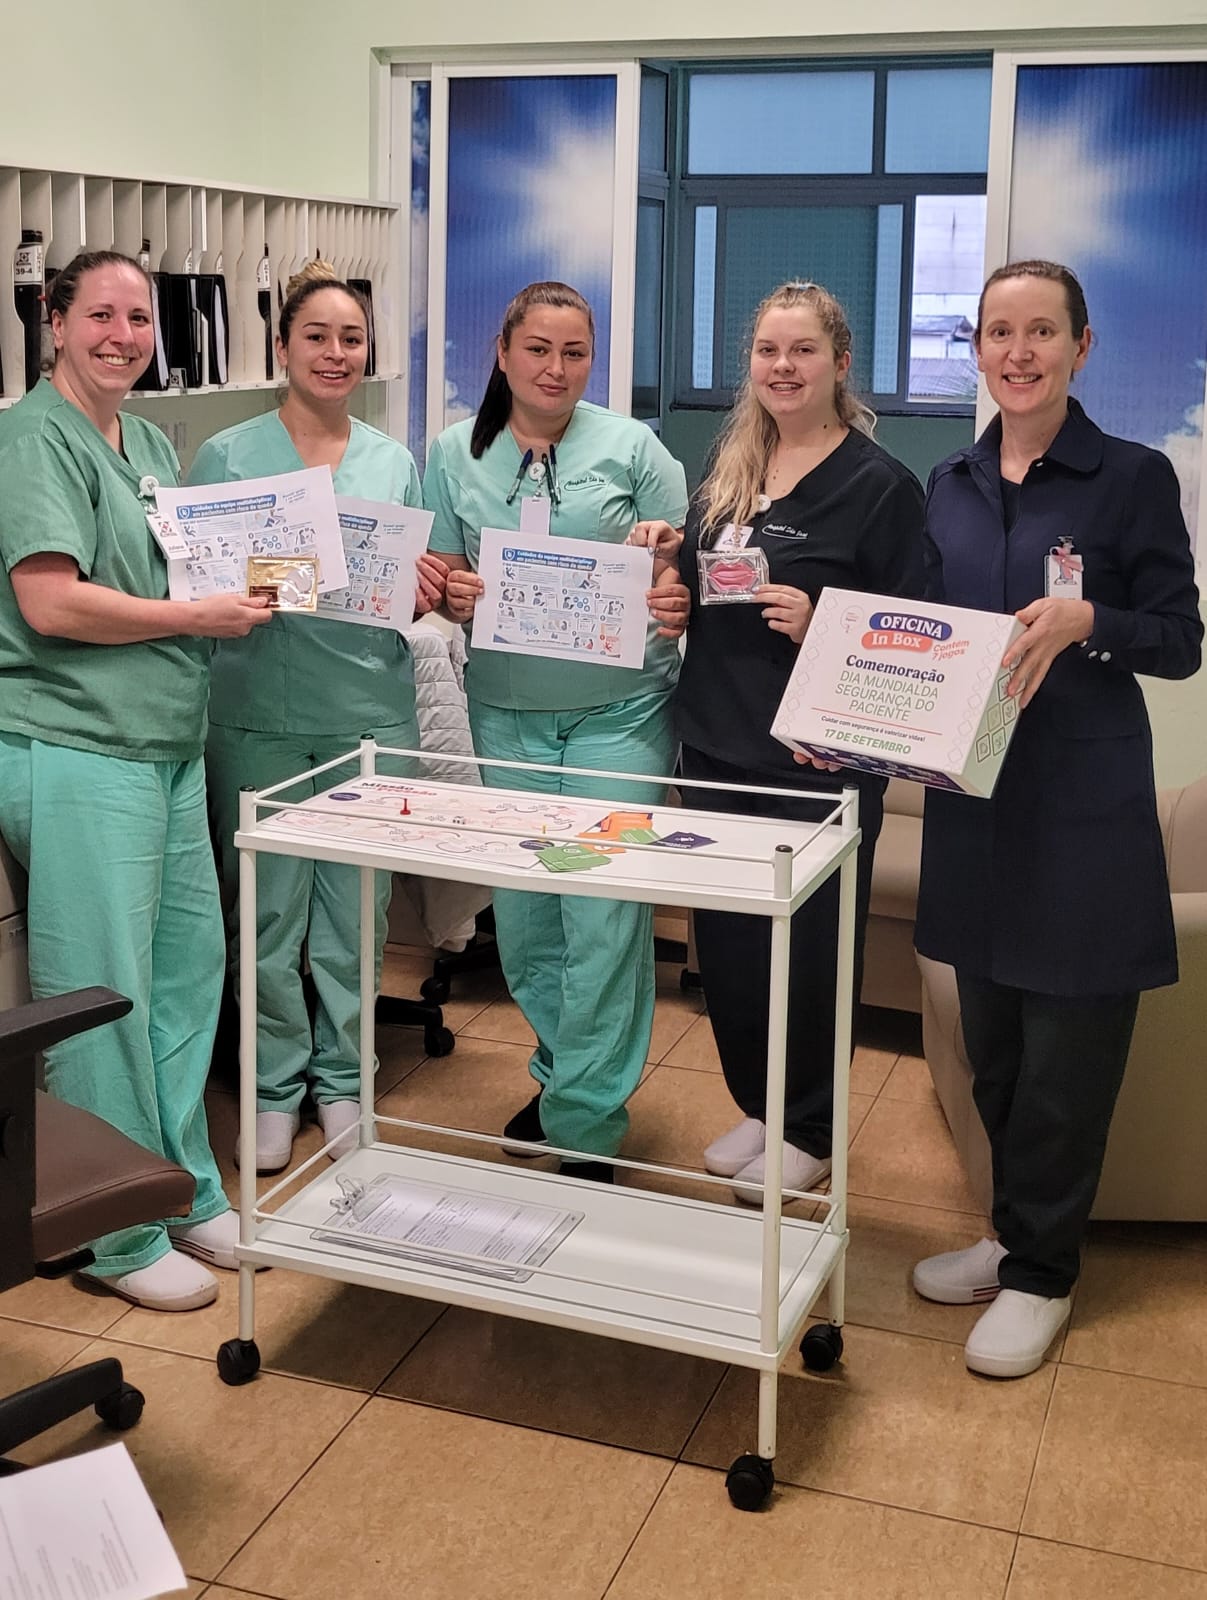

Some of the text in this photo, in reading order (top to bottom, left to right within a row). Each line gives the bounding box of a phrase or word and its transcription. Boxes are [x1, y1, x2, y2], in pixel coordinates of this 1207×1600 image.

[880, 615, 943, 638] OFICINA
[872, 633, 922, 647] In Box
[934, 640, 970, 652] Contém
[840, 670, 860, 684] DIA
[846, 654, 945, 684] Comemoração
[835, 683, 935, 712] SEGURANÇA DO
[849, 700, 911, 721] PACIENTE
[821, 715, 839, 724] Cuidar
[852, 722, 879, 733] segurança
[884, 728, 908, 739] valorizar
[824, 729, 911, 754] 17 DE SETEMBRO
